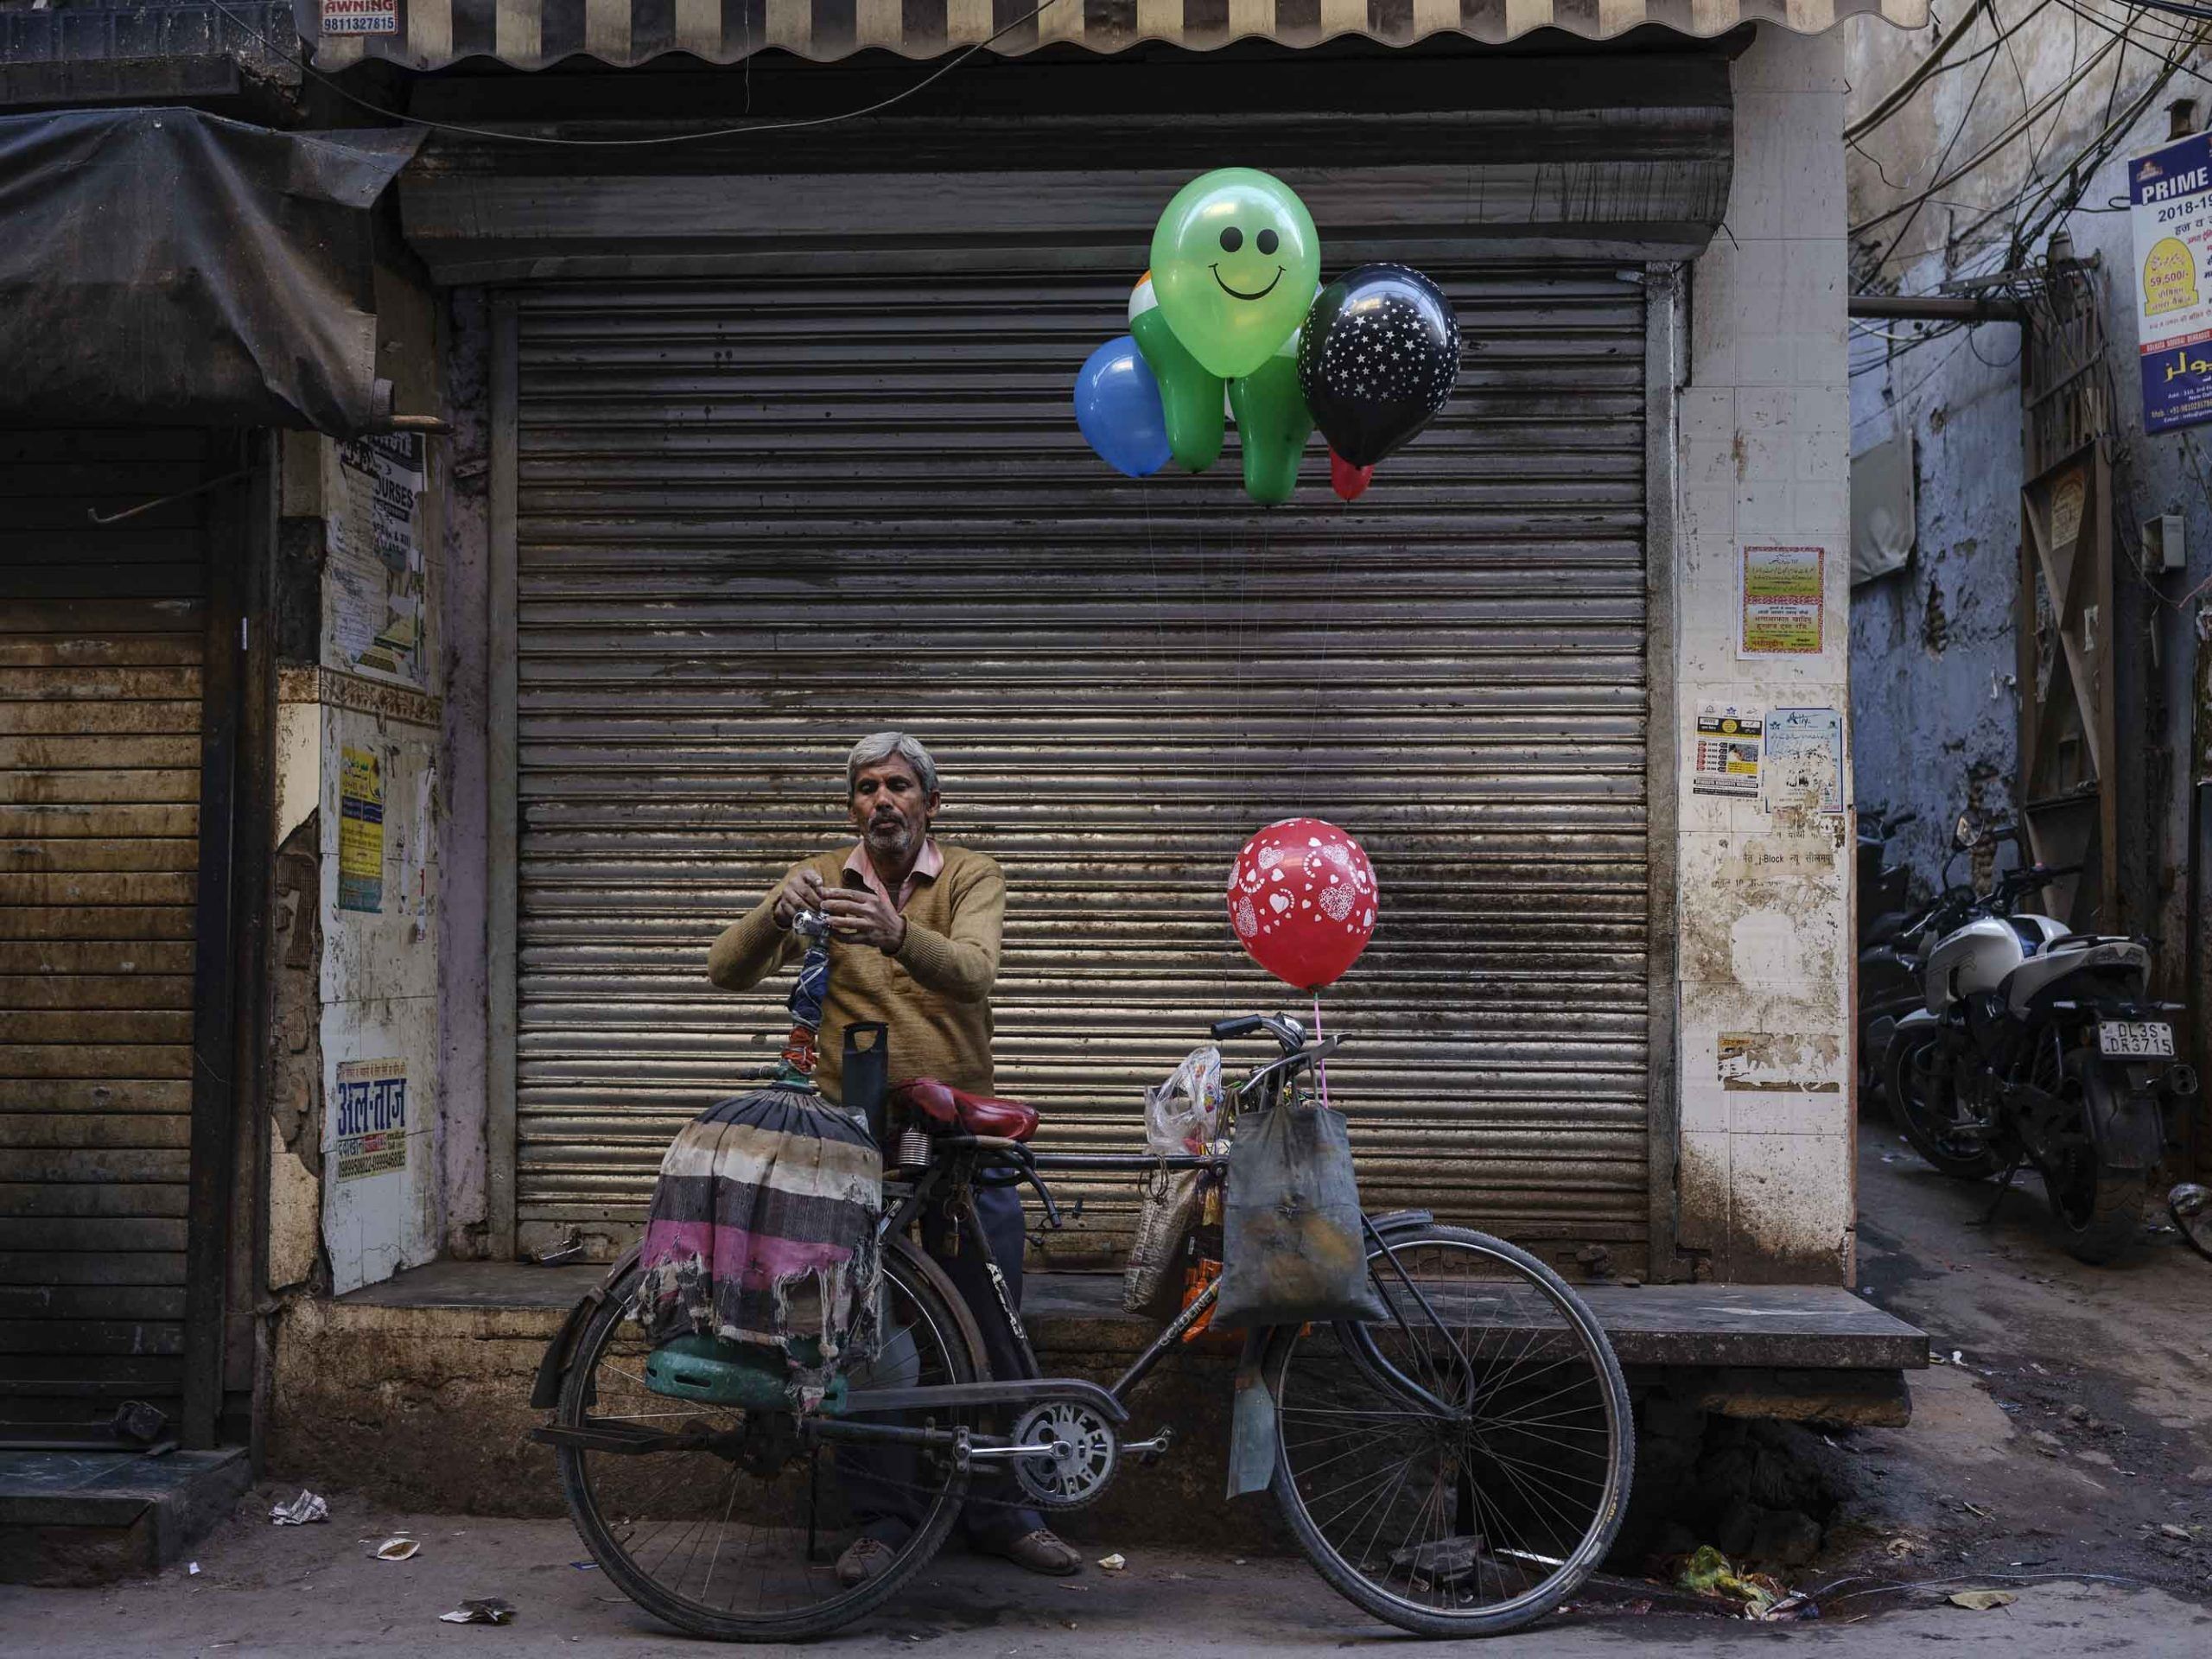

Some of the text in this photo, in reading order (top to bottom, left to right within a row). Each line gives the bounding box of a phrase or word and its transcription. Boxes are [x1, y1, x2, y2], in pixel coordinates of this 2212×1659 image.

[324, 0, 394, 13] AWNING
[324, 17, 394, 31] 9811327815
[2141, 166, 2209, 206] PRIME
[2150, 270, 2189, 287] 59,500/-
[2118, 1023, 2158, 1038] DL3S
